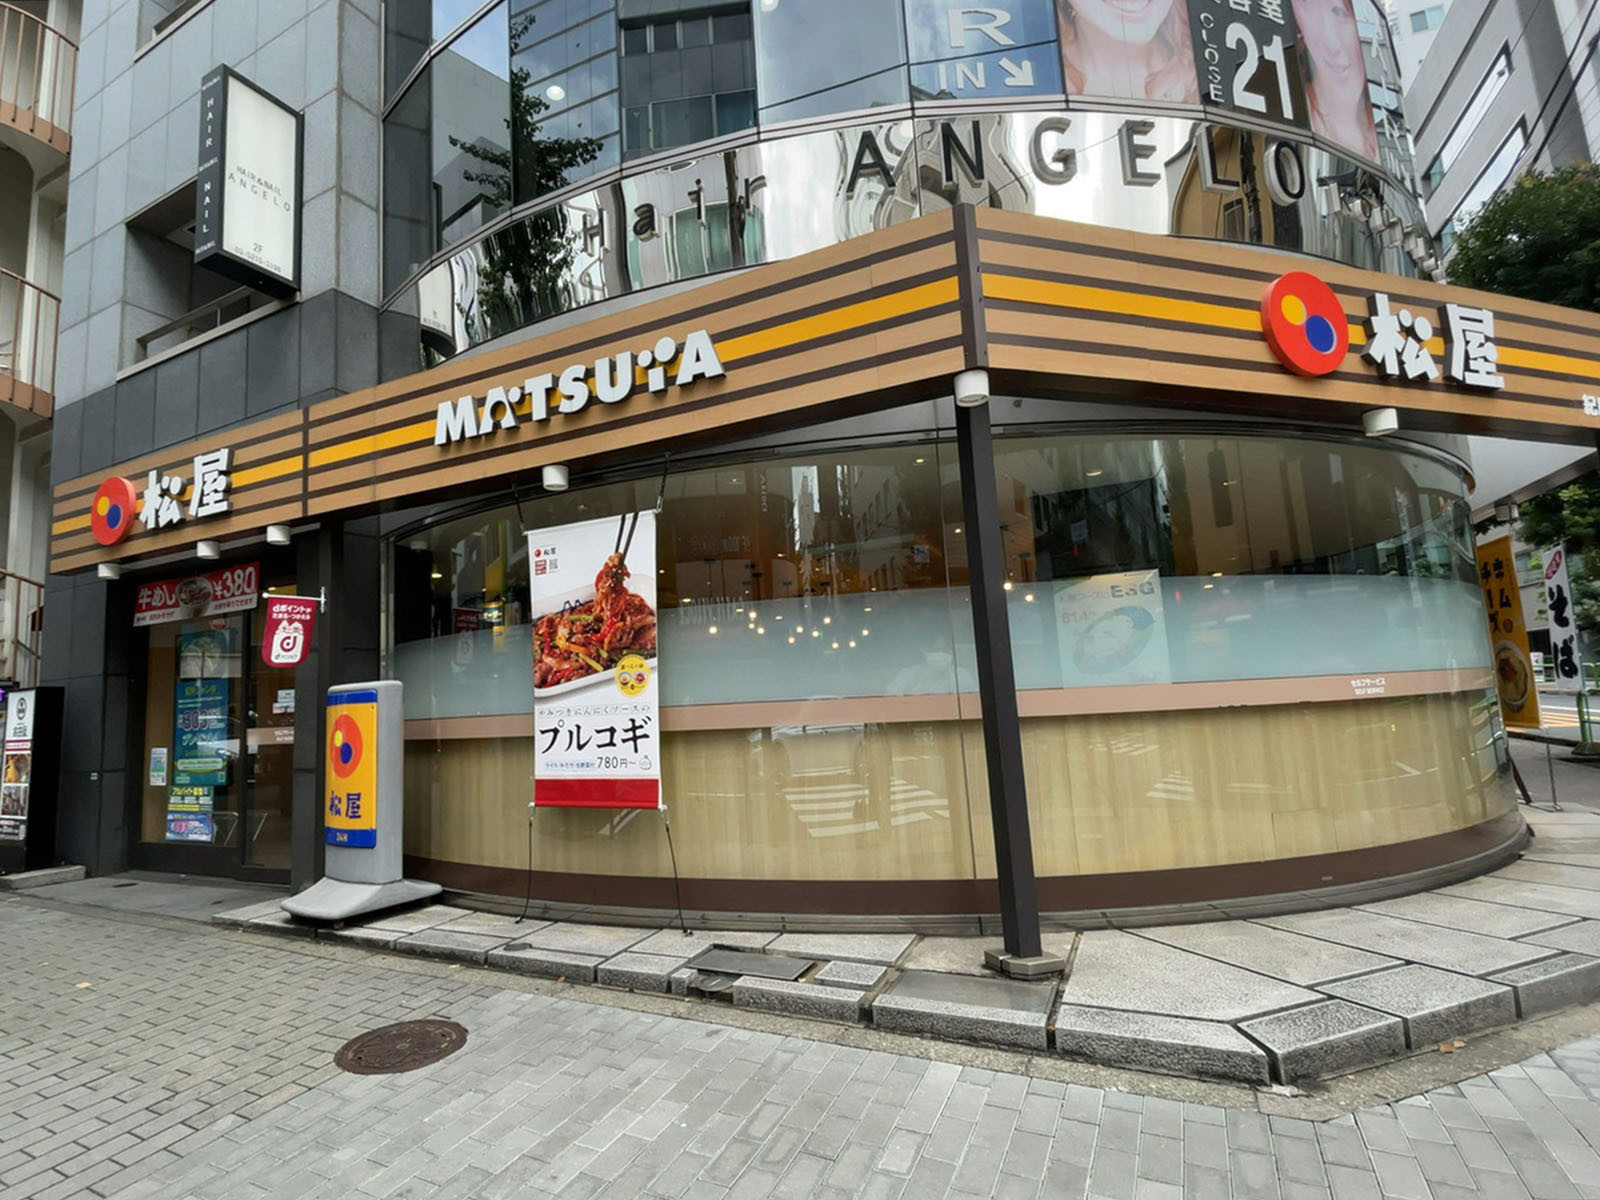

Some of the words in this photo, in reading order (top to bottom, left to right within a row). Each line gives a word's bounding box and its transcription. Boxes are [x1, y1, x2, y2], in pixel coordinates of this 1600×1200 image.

[938, 61, 986, 90] IN
[1200, 12, 1225, 103] CLOSE
[1225, 22, 1294, 120] 21
[205, 97, 214, 148] HAIR
[228, 172, 291, 213] ANGELO
[846, 116, 1308, 207] ANGELO
[203, 181, 212, 234] NAIL
[582, 174, 768, 262] Hair
[1362, 292, 1505, 390] 松屋
[434, 329, 727, 447] MATSUYA
[1582, 393, 1600, 417] 紀
[139, 448, 233, 530] 松屋
[138, 585, 176, 611] 牛めし
[213, 567, 255, 599] ¥380
[1549, 584, 1579, 680] そば
[539, 715, 652, 755] プルコギ
[328, 790, 362, 819] 松屋
